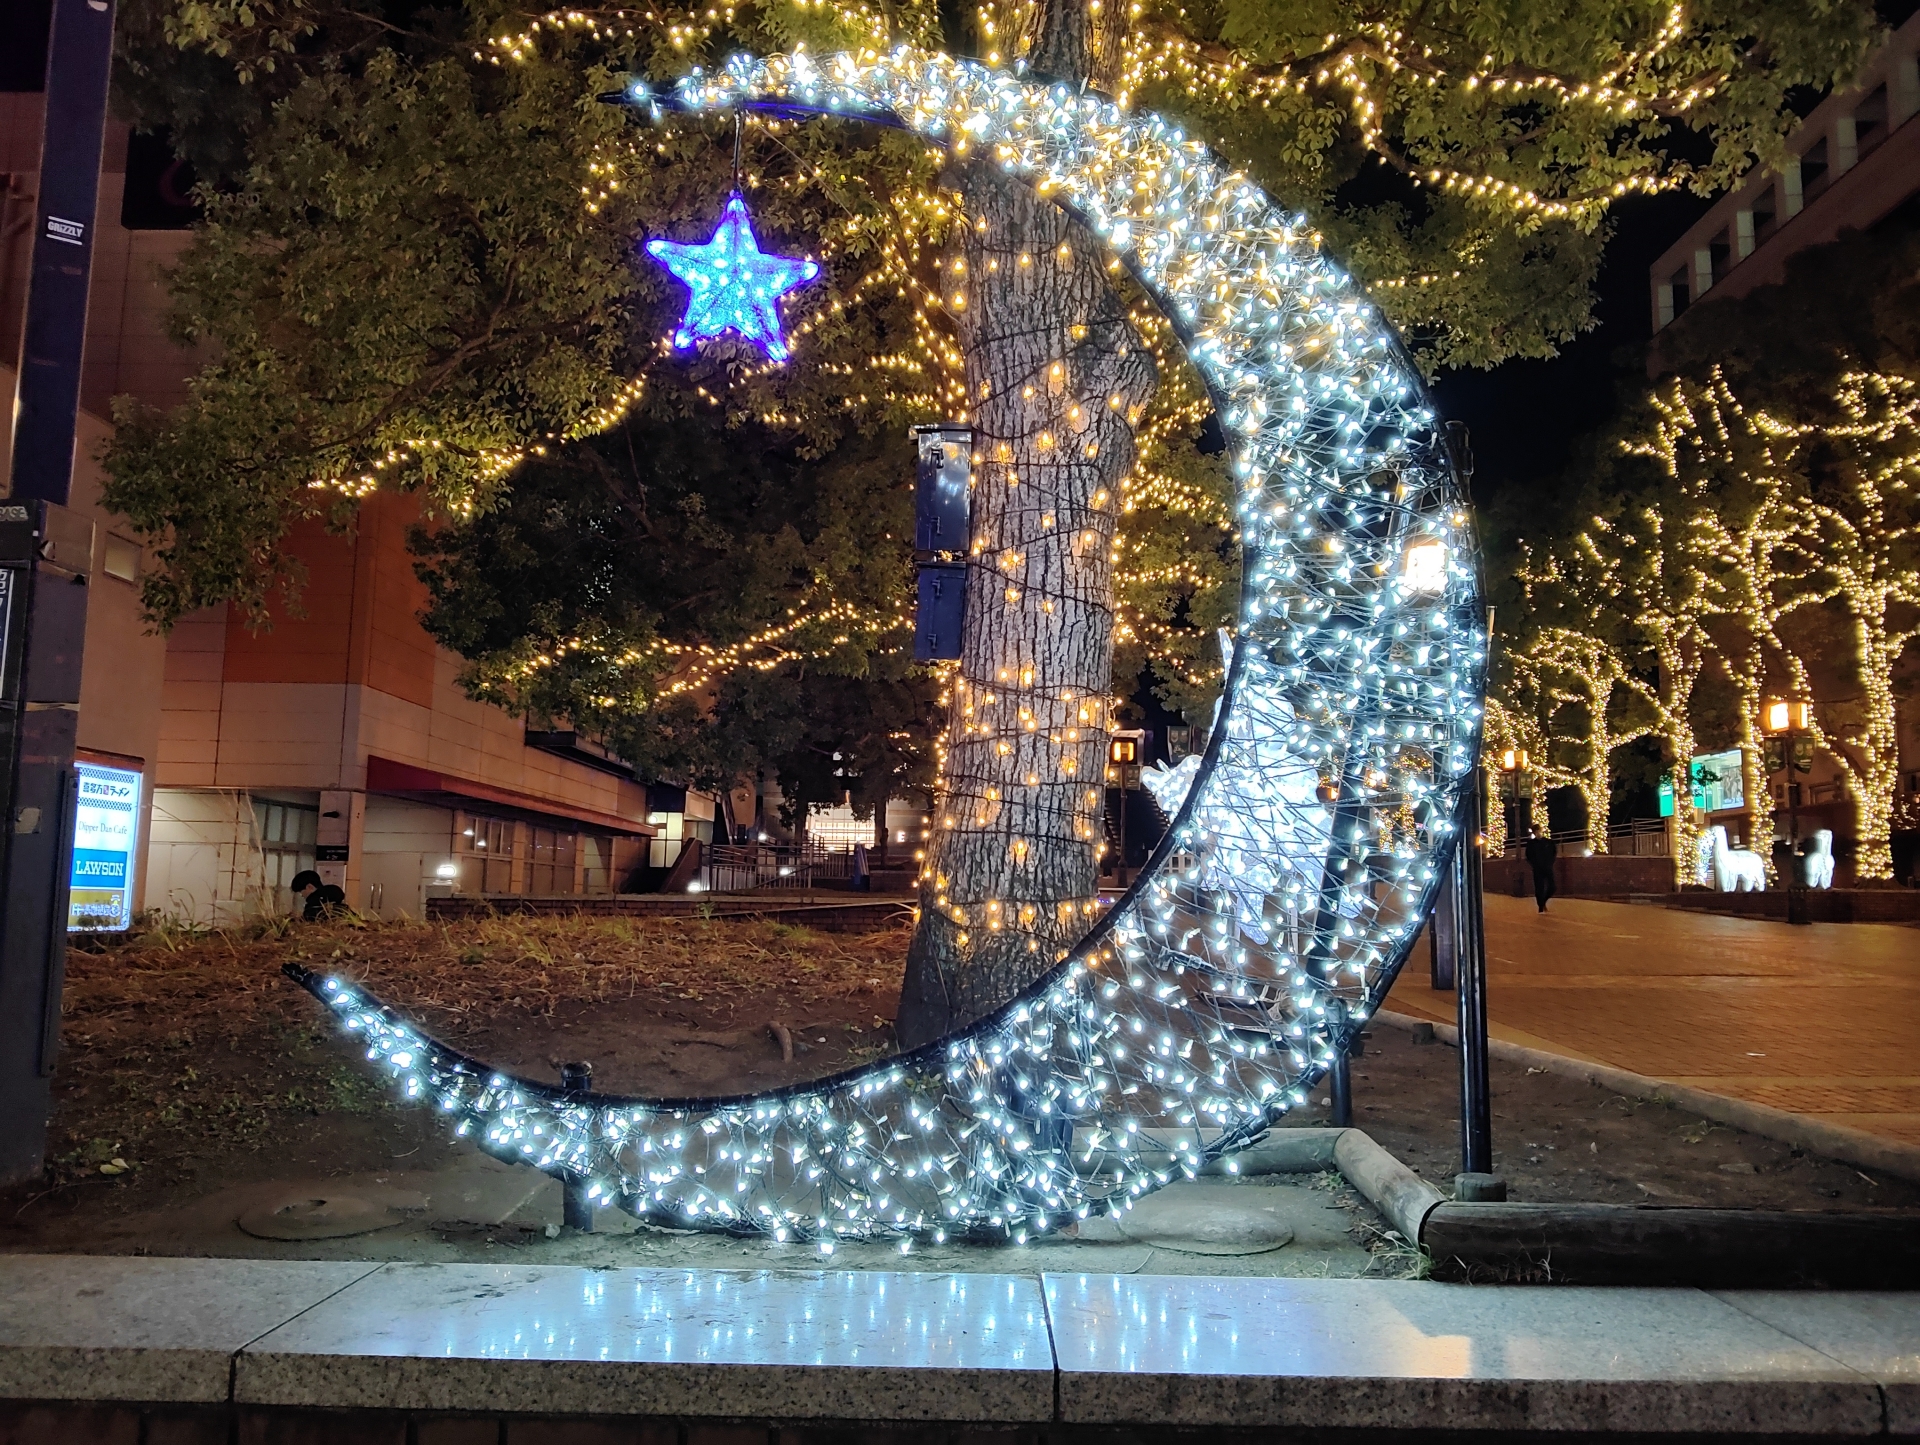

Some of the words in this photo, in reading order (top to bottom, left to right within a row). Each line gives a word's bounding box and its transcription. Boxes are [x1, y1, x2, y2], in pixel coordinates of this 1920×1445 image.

[47, 221, 83, 237] GRIZZLY
[78, 821, 98, 834] Dipper
[100, 823, 112, 833] Dan
[75, 860, 124, 876] LAWSON
